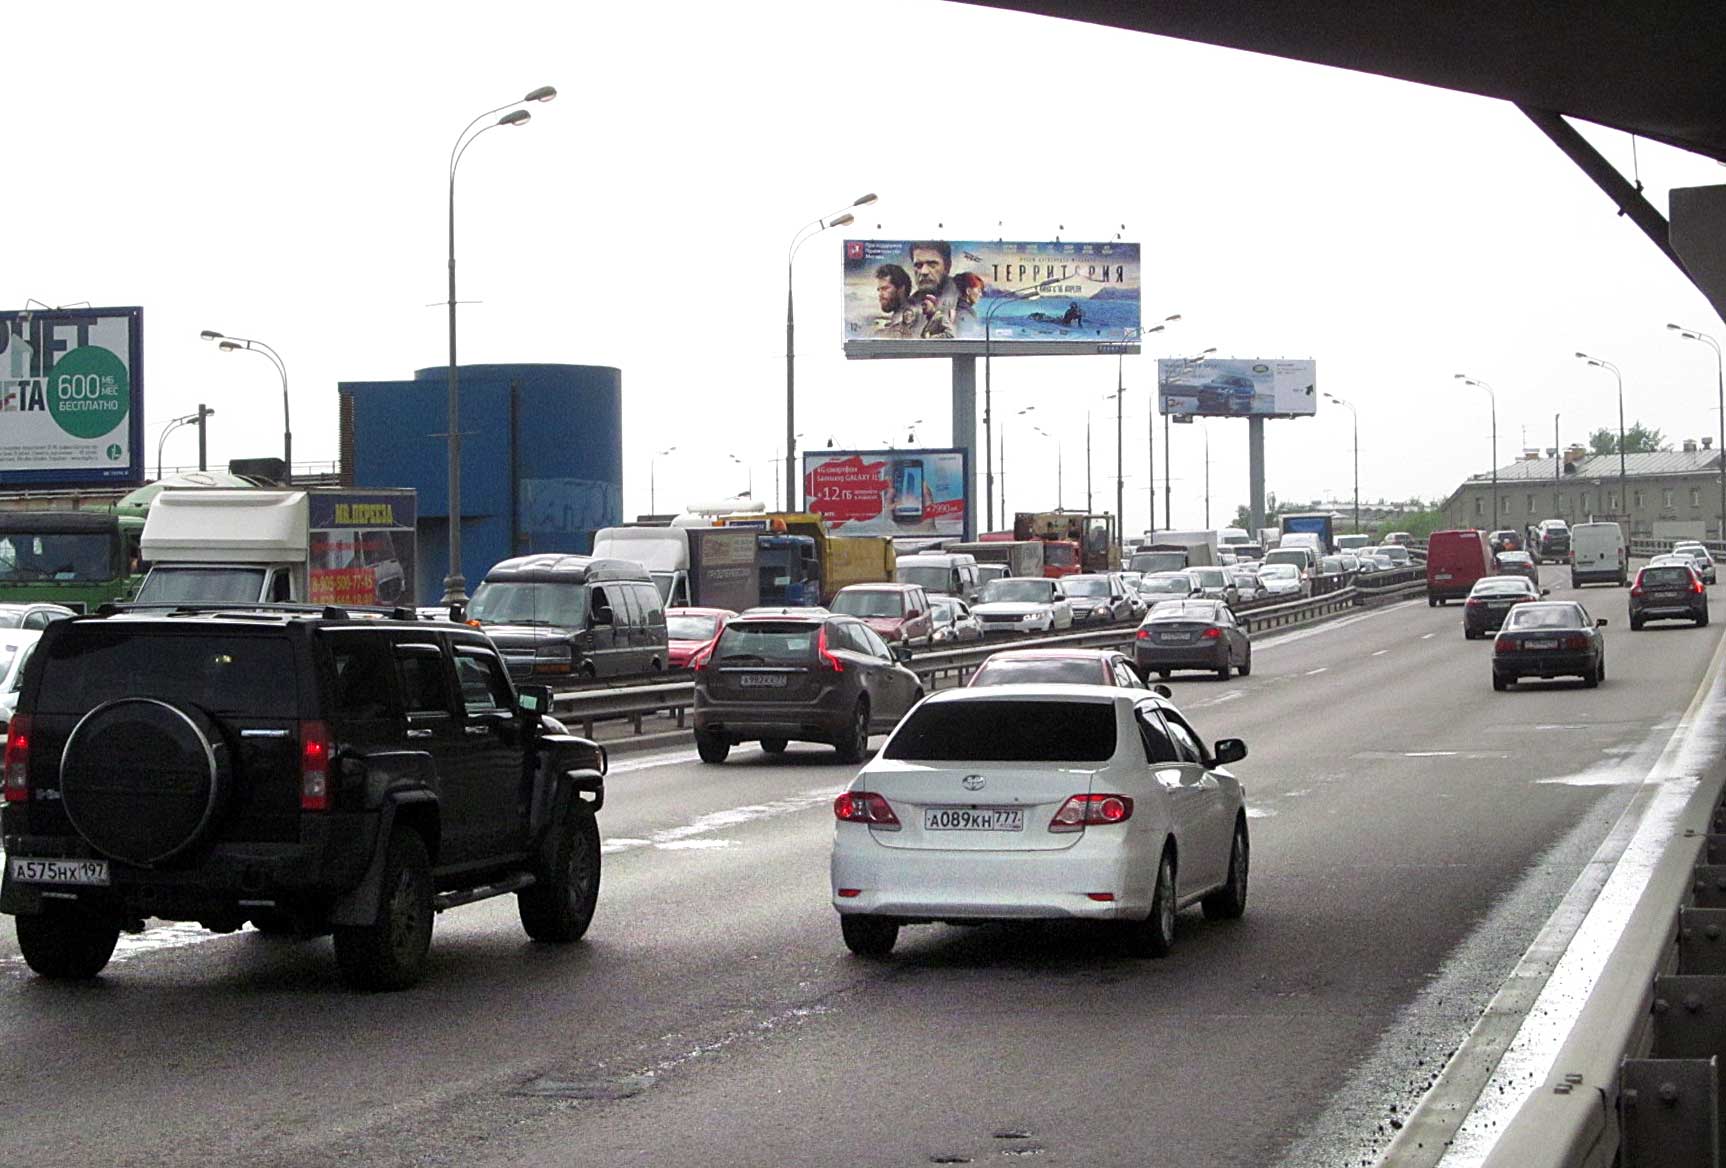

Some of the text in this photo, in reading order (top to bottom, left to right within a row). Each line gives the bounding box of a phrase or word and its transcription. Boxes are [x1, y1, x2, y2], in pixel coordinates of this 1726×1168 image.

[58, 374, 99, 399] 600
[58, 400, 118, 411] БЕСПЛАТНО
[823, 486, 840, 500] 12
